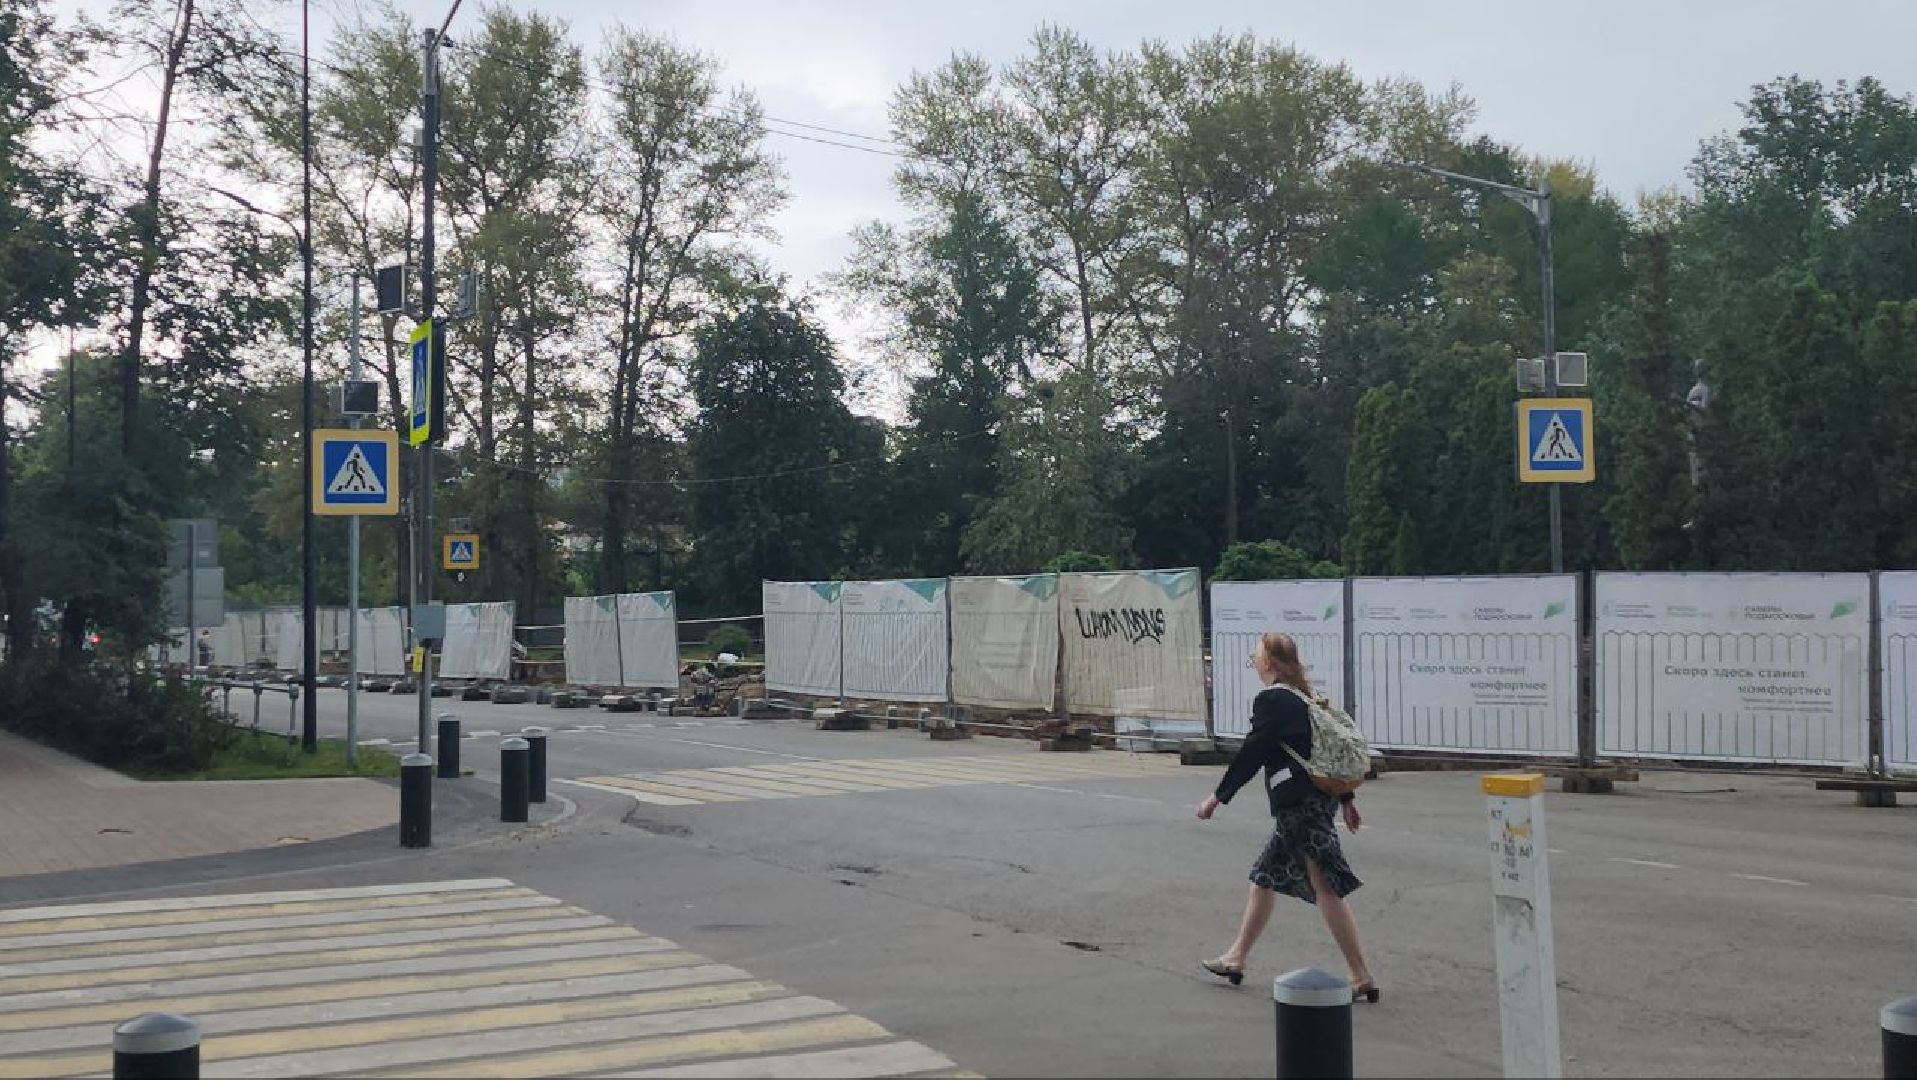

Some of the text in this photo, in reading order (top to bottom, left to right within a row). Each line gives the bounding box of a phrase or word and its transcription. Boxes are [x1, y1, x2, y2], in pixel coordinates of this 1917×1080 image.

[1410, 663, 1526, 675] Скоро здесь станет
[1665, 664, 1805, 679] Скоро здесь станет
[1470, 681, 1547, 691] комфортнее
[1738, 685, 1832, 696] комфортнее
